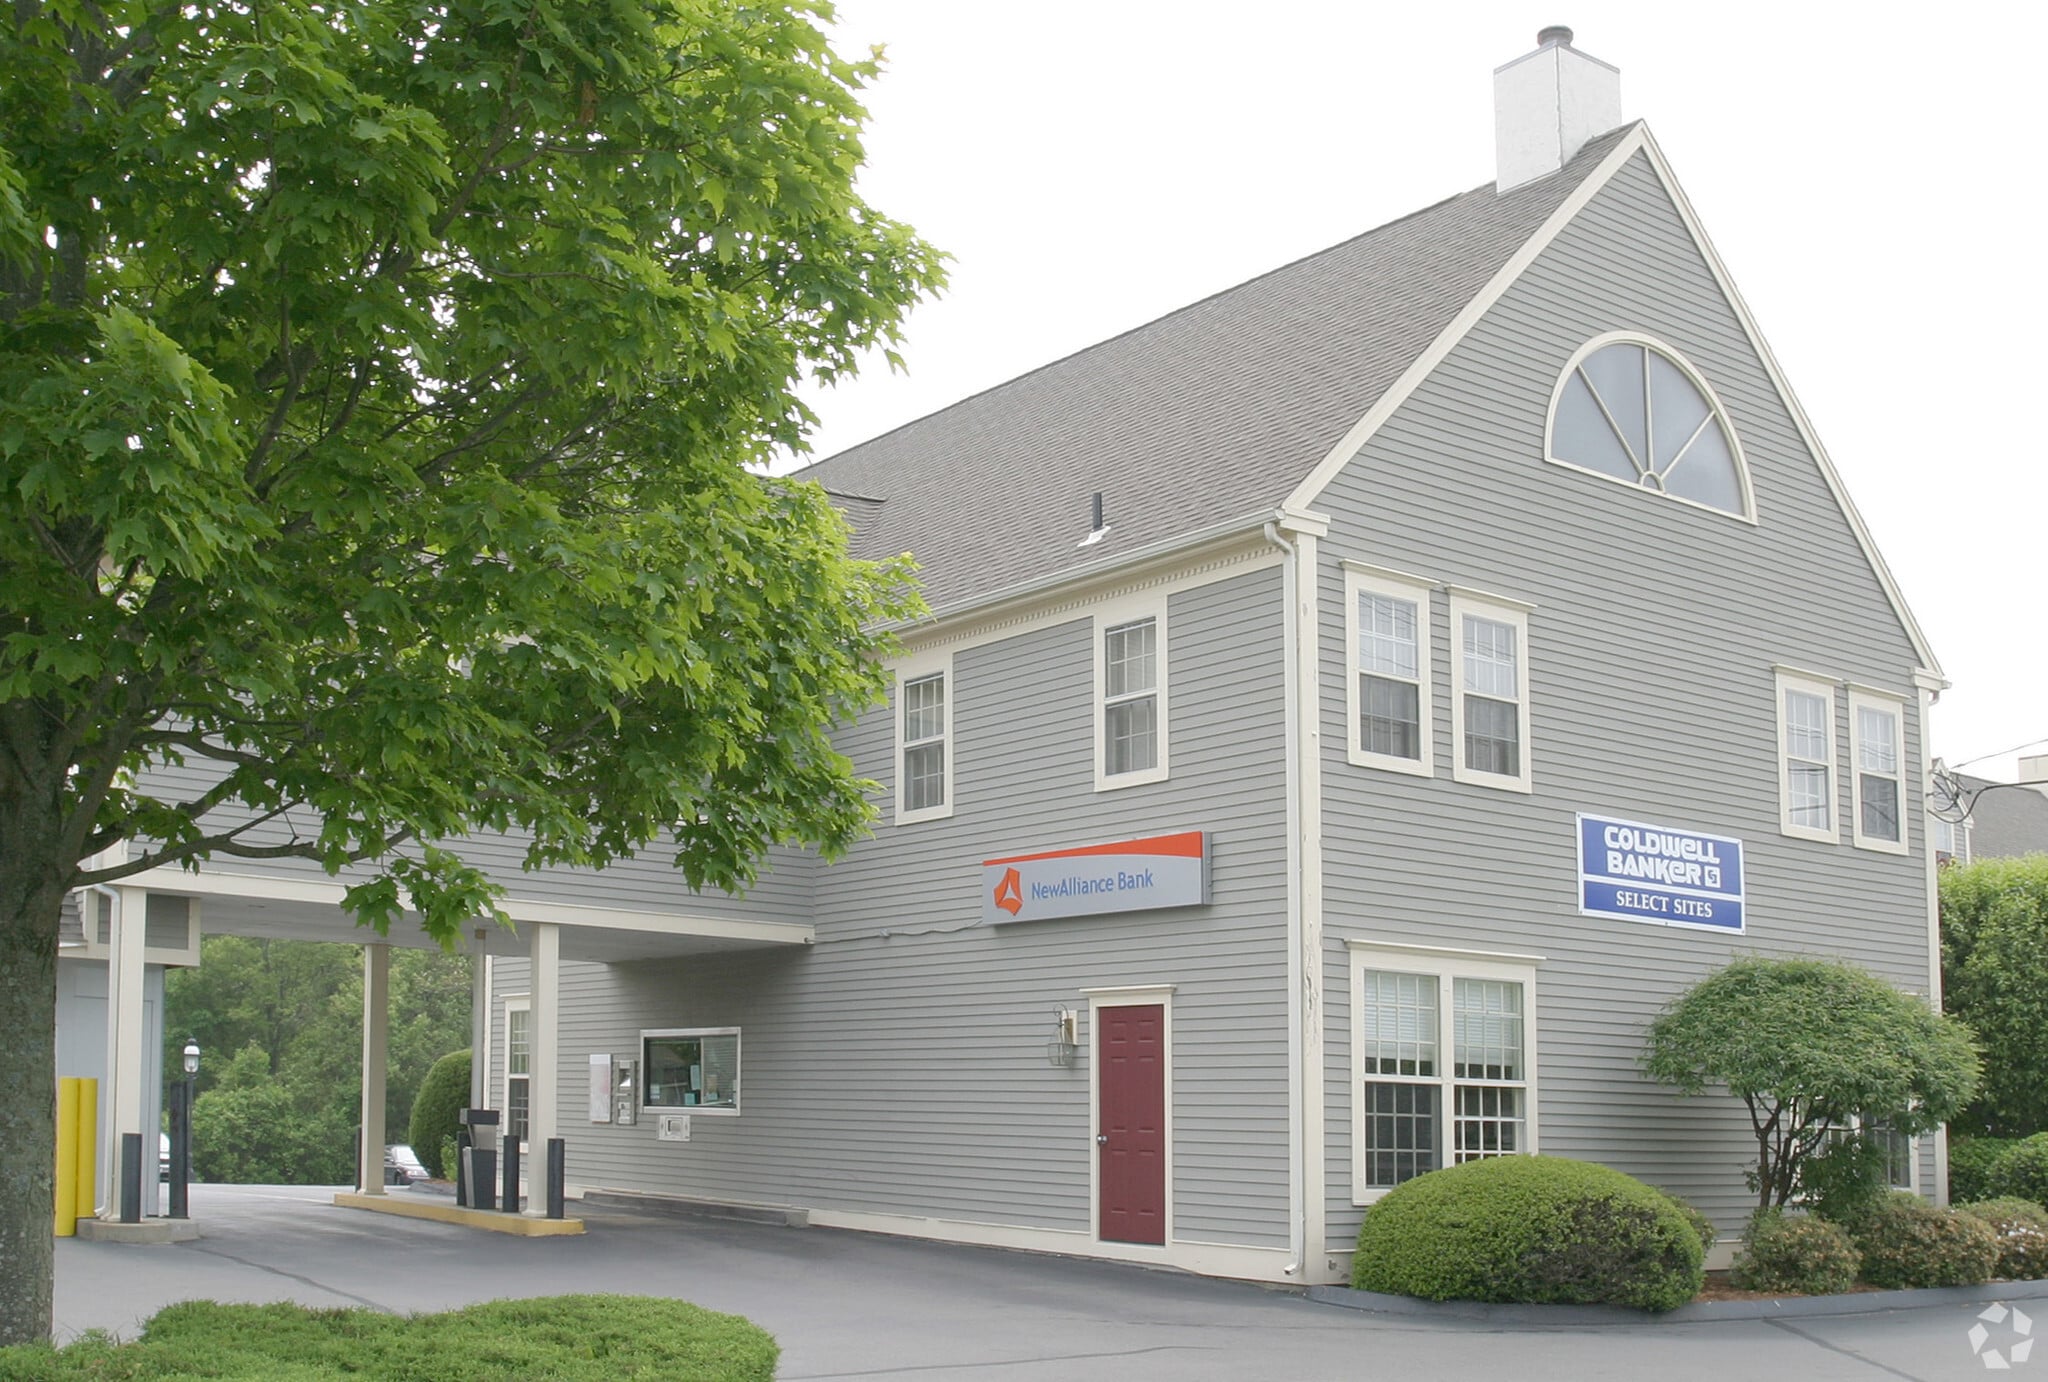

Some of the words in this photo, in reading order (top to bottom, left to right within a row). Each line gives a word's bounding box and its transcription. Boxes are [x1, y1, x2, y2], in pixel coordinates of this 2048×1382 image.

[1031, 876, 1114, 900] NewAlliance
[1117, 868, 1154, 890] Bank
[1616, 890, 1669, 912] SELECT
[1673, 898, 1713, 918] SITES
